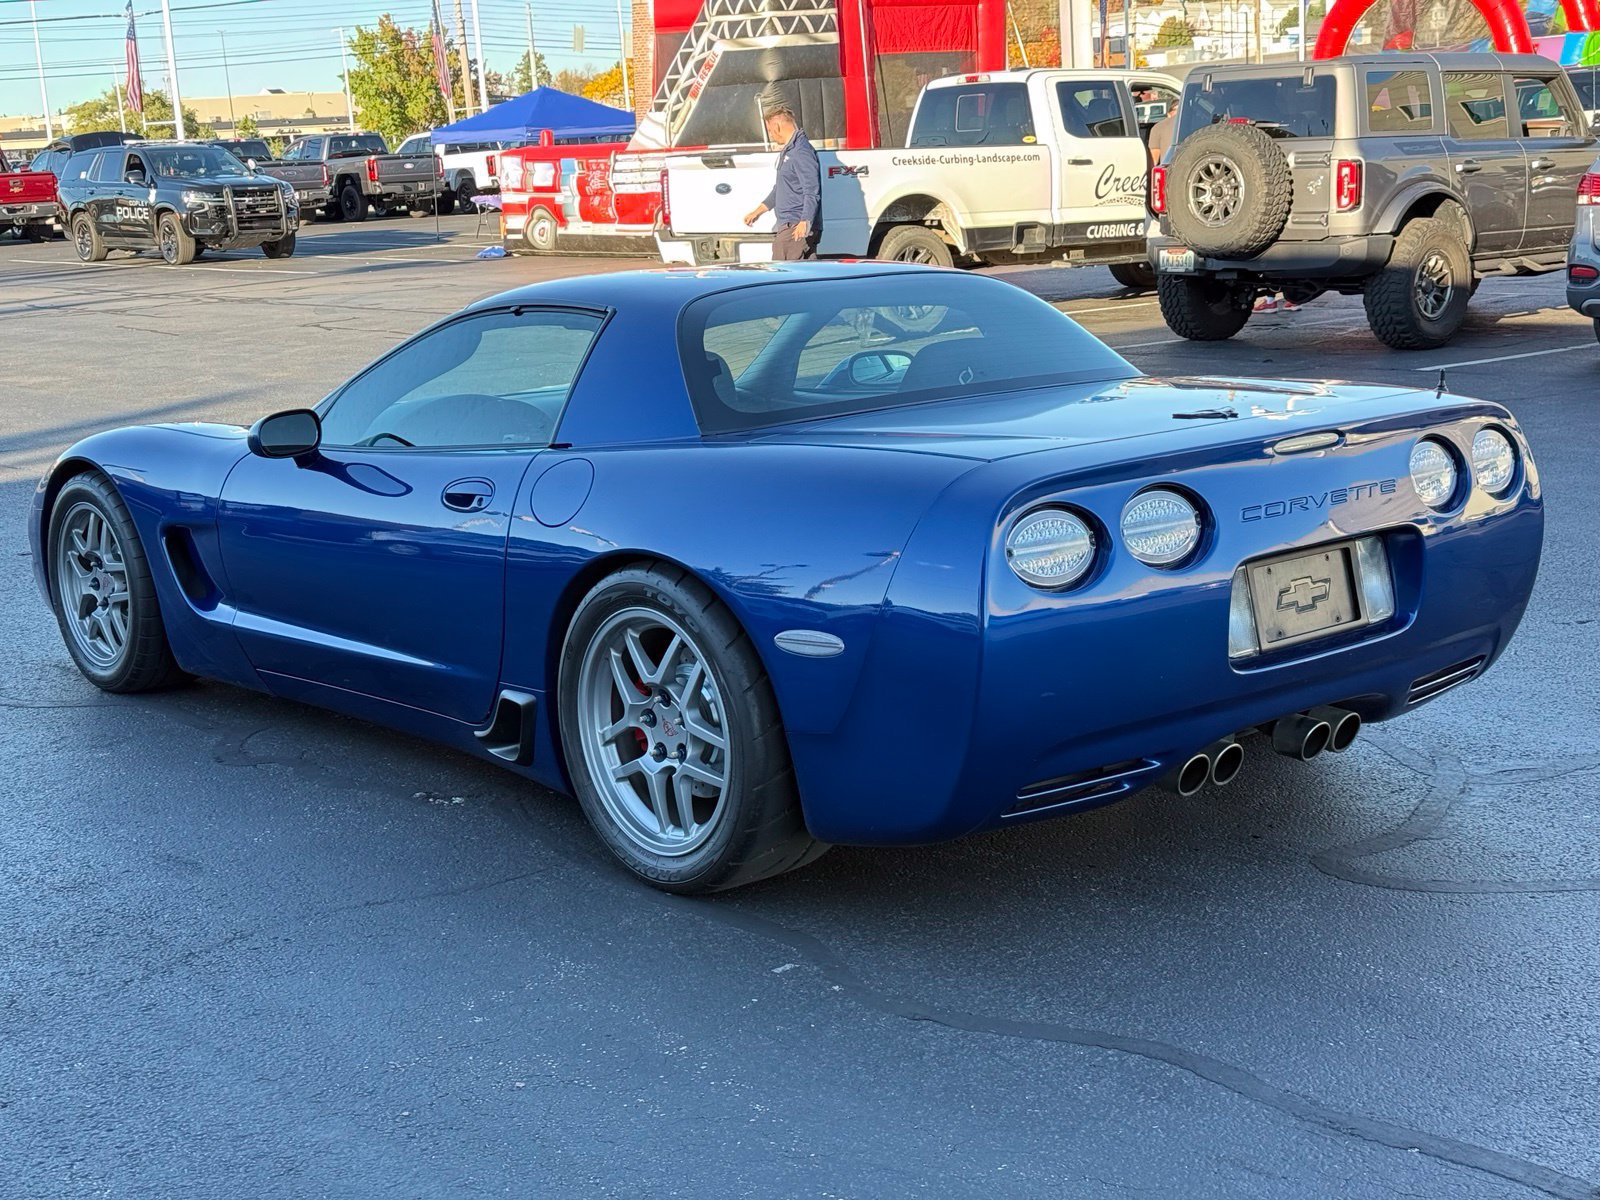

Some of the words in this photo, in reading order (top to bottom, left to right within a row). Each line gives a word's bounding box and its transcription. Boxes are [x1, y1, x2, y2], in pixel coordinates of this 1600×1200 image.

[892, 153, 1040, 166] Creekside-Curbing-Landscape.com
[828, 165, 869, 178] FX4
[116, 207, 149, 219] POLICE
[1087, 223, 1135, 238] CURBING
[1241, 479, 1396, 523] CORVETTE
[643, 586, 700, 633] TOYO
